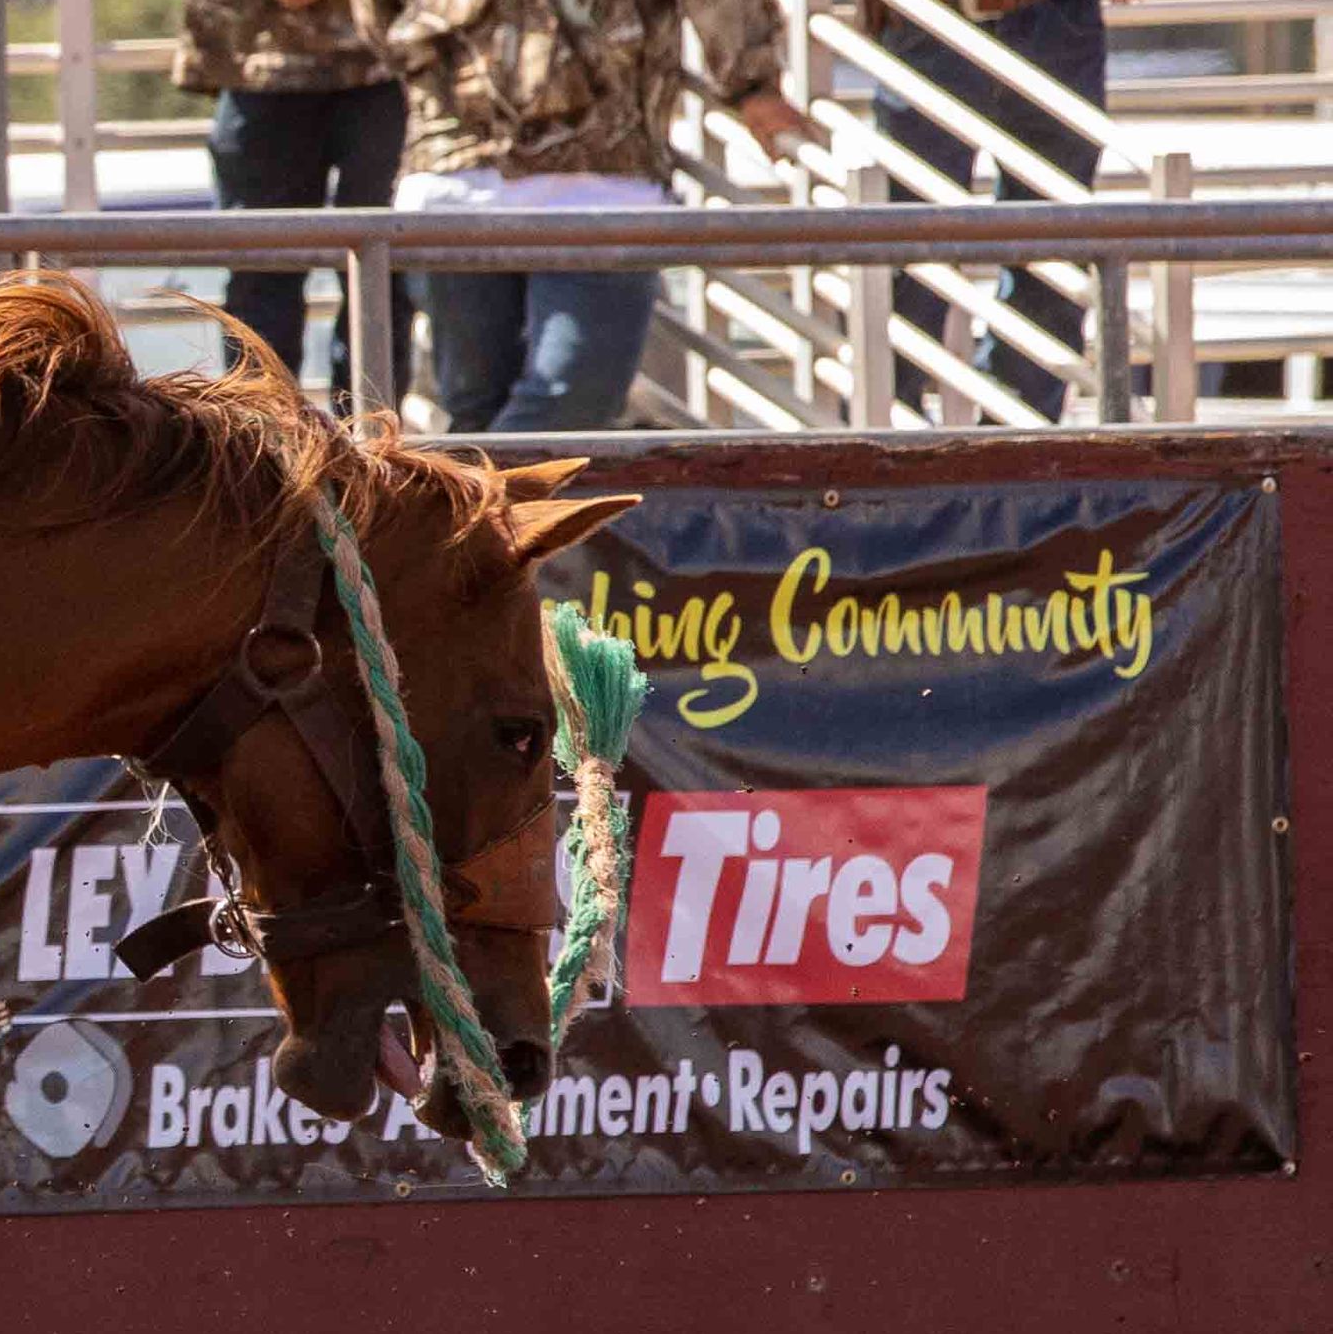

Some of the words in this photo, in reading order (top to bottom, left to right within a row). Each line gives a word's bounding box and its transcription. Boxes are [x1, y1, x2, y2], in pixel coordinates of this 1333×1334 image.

[770, 547, 1153, 679] Community
[661, 809, 954, 984] Tires
[727, 1045, 953, 1155] Repairs
